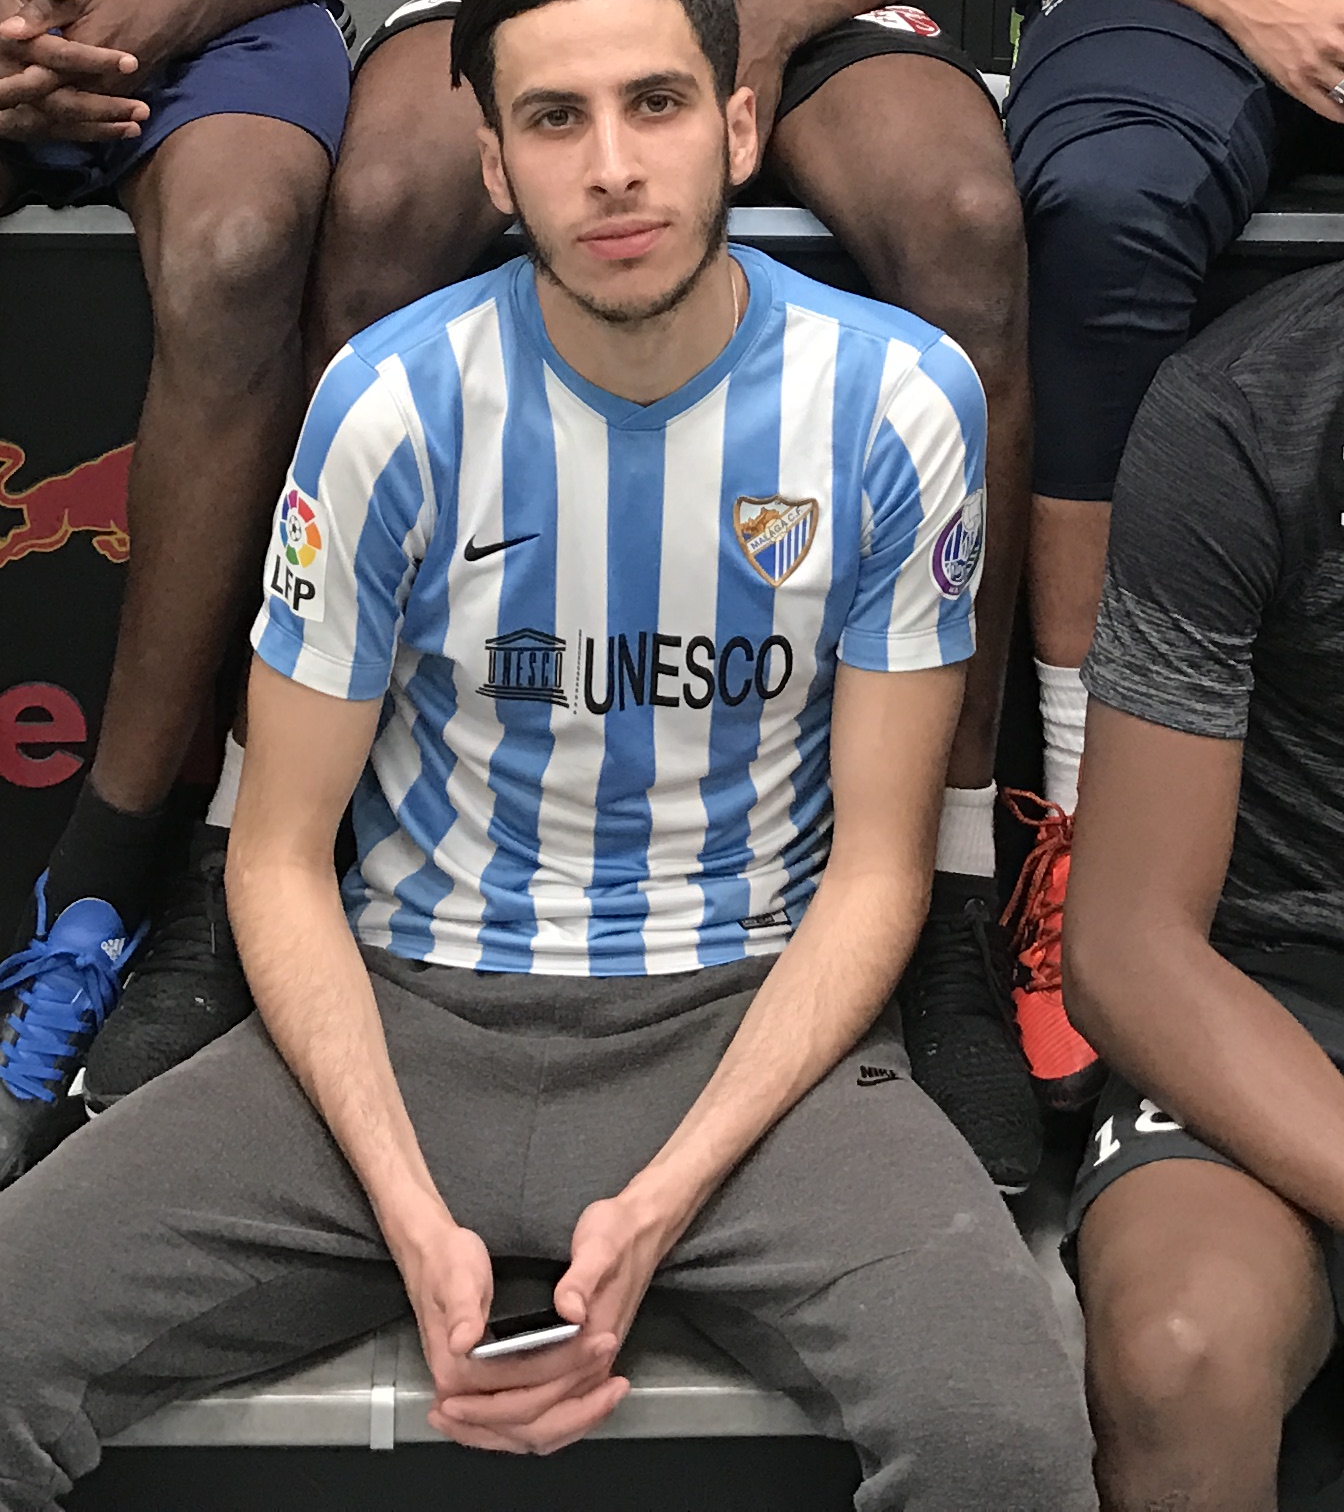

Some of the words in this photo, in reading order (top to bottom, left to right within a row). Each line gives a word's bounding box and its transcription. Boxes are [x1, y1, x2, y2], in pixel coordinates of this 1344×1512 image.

[270, 554, 316, 612] LFP
[584, 631, 794, 715] UNESCO
[859, 1064, 897, 1079] NIKE
